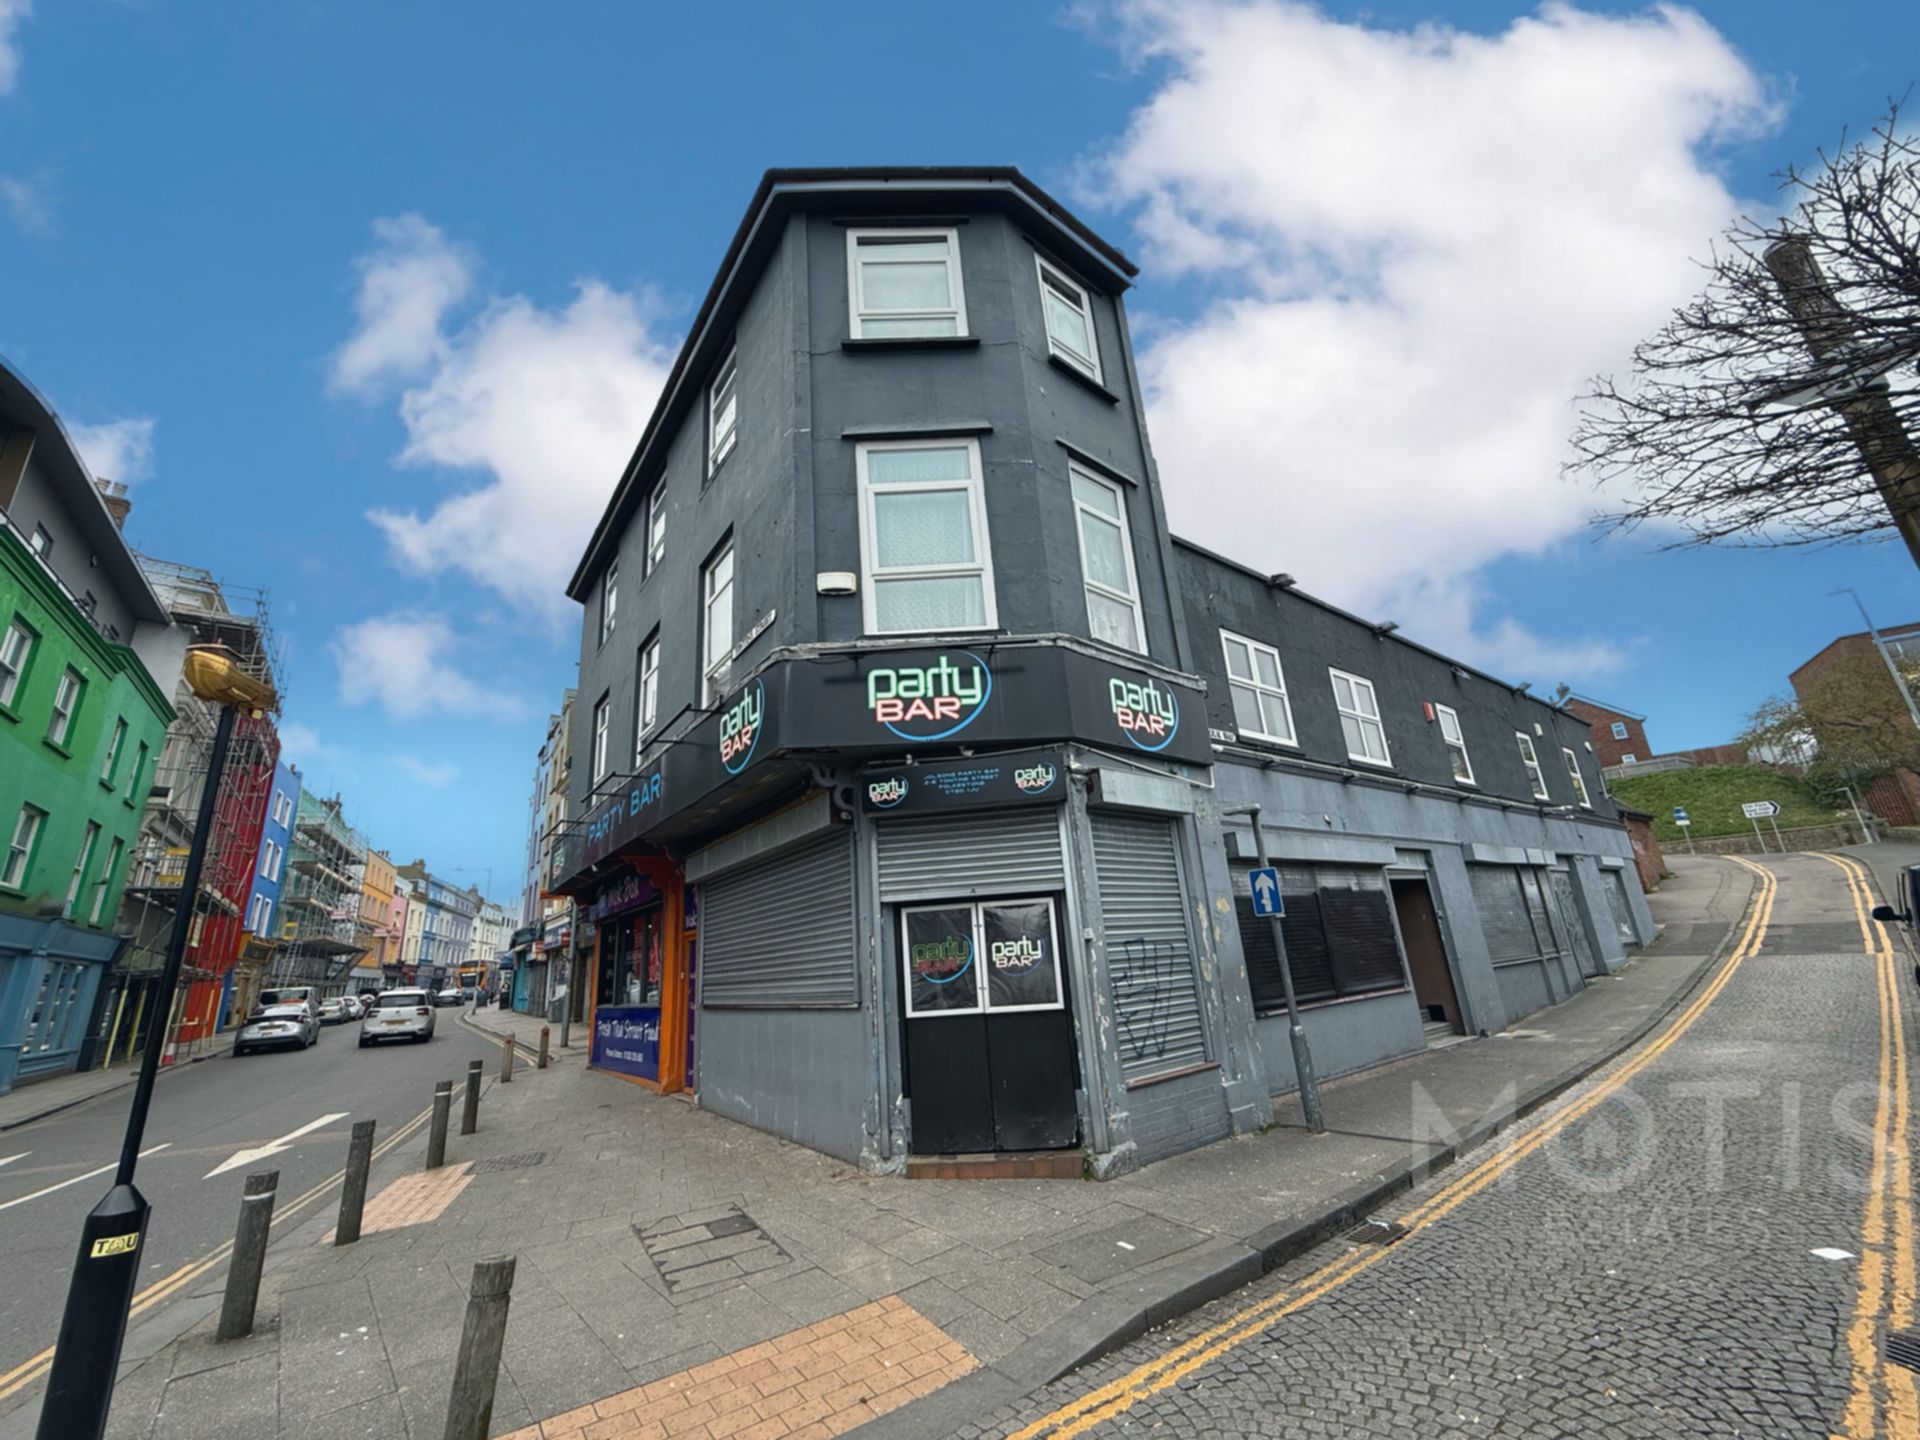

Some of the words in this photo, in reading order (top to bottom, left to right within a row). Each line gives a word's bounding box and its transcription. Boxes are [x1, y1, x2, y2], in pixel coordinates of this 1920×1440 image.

[868, 655, 983, 709] party
[876, 697, 961, 722] BAR
[1109, 678, 1175, 727] party
[719, 687, 760, 752] party
[1117, 707, 1165, 737] BAR
[722, 725, 752, 763] BAR
[868, 777, 905, 798] party
[1014, 763, 1053, 784] party
[1018, 777, 1046, 789] BAR
[588, 799, 625, 848] PARTY
[629, 772, 661, 817] BAR
[871, 792, 898, 802] BAR
[912, 935, 970, 967] party
[992, 934, 1042, 962] party
[995, 955, 1033, 968] BAR
[916, 956, 960, 974] BAR
